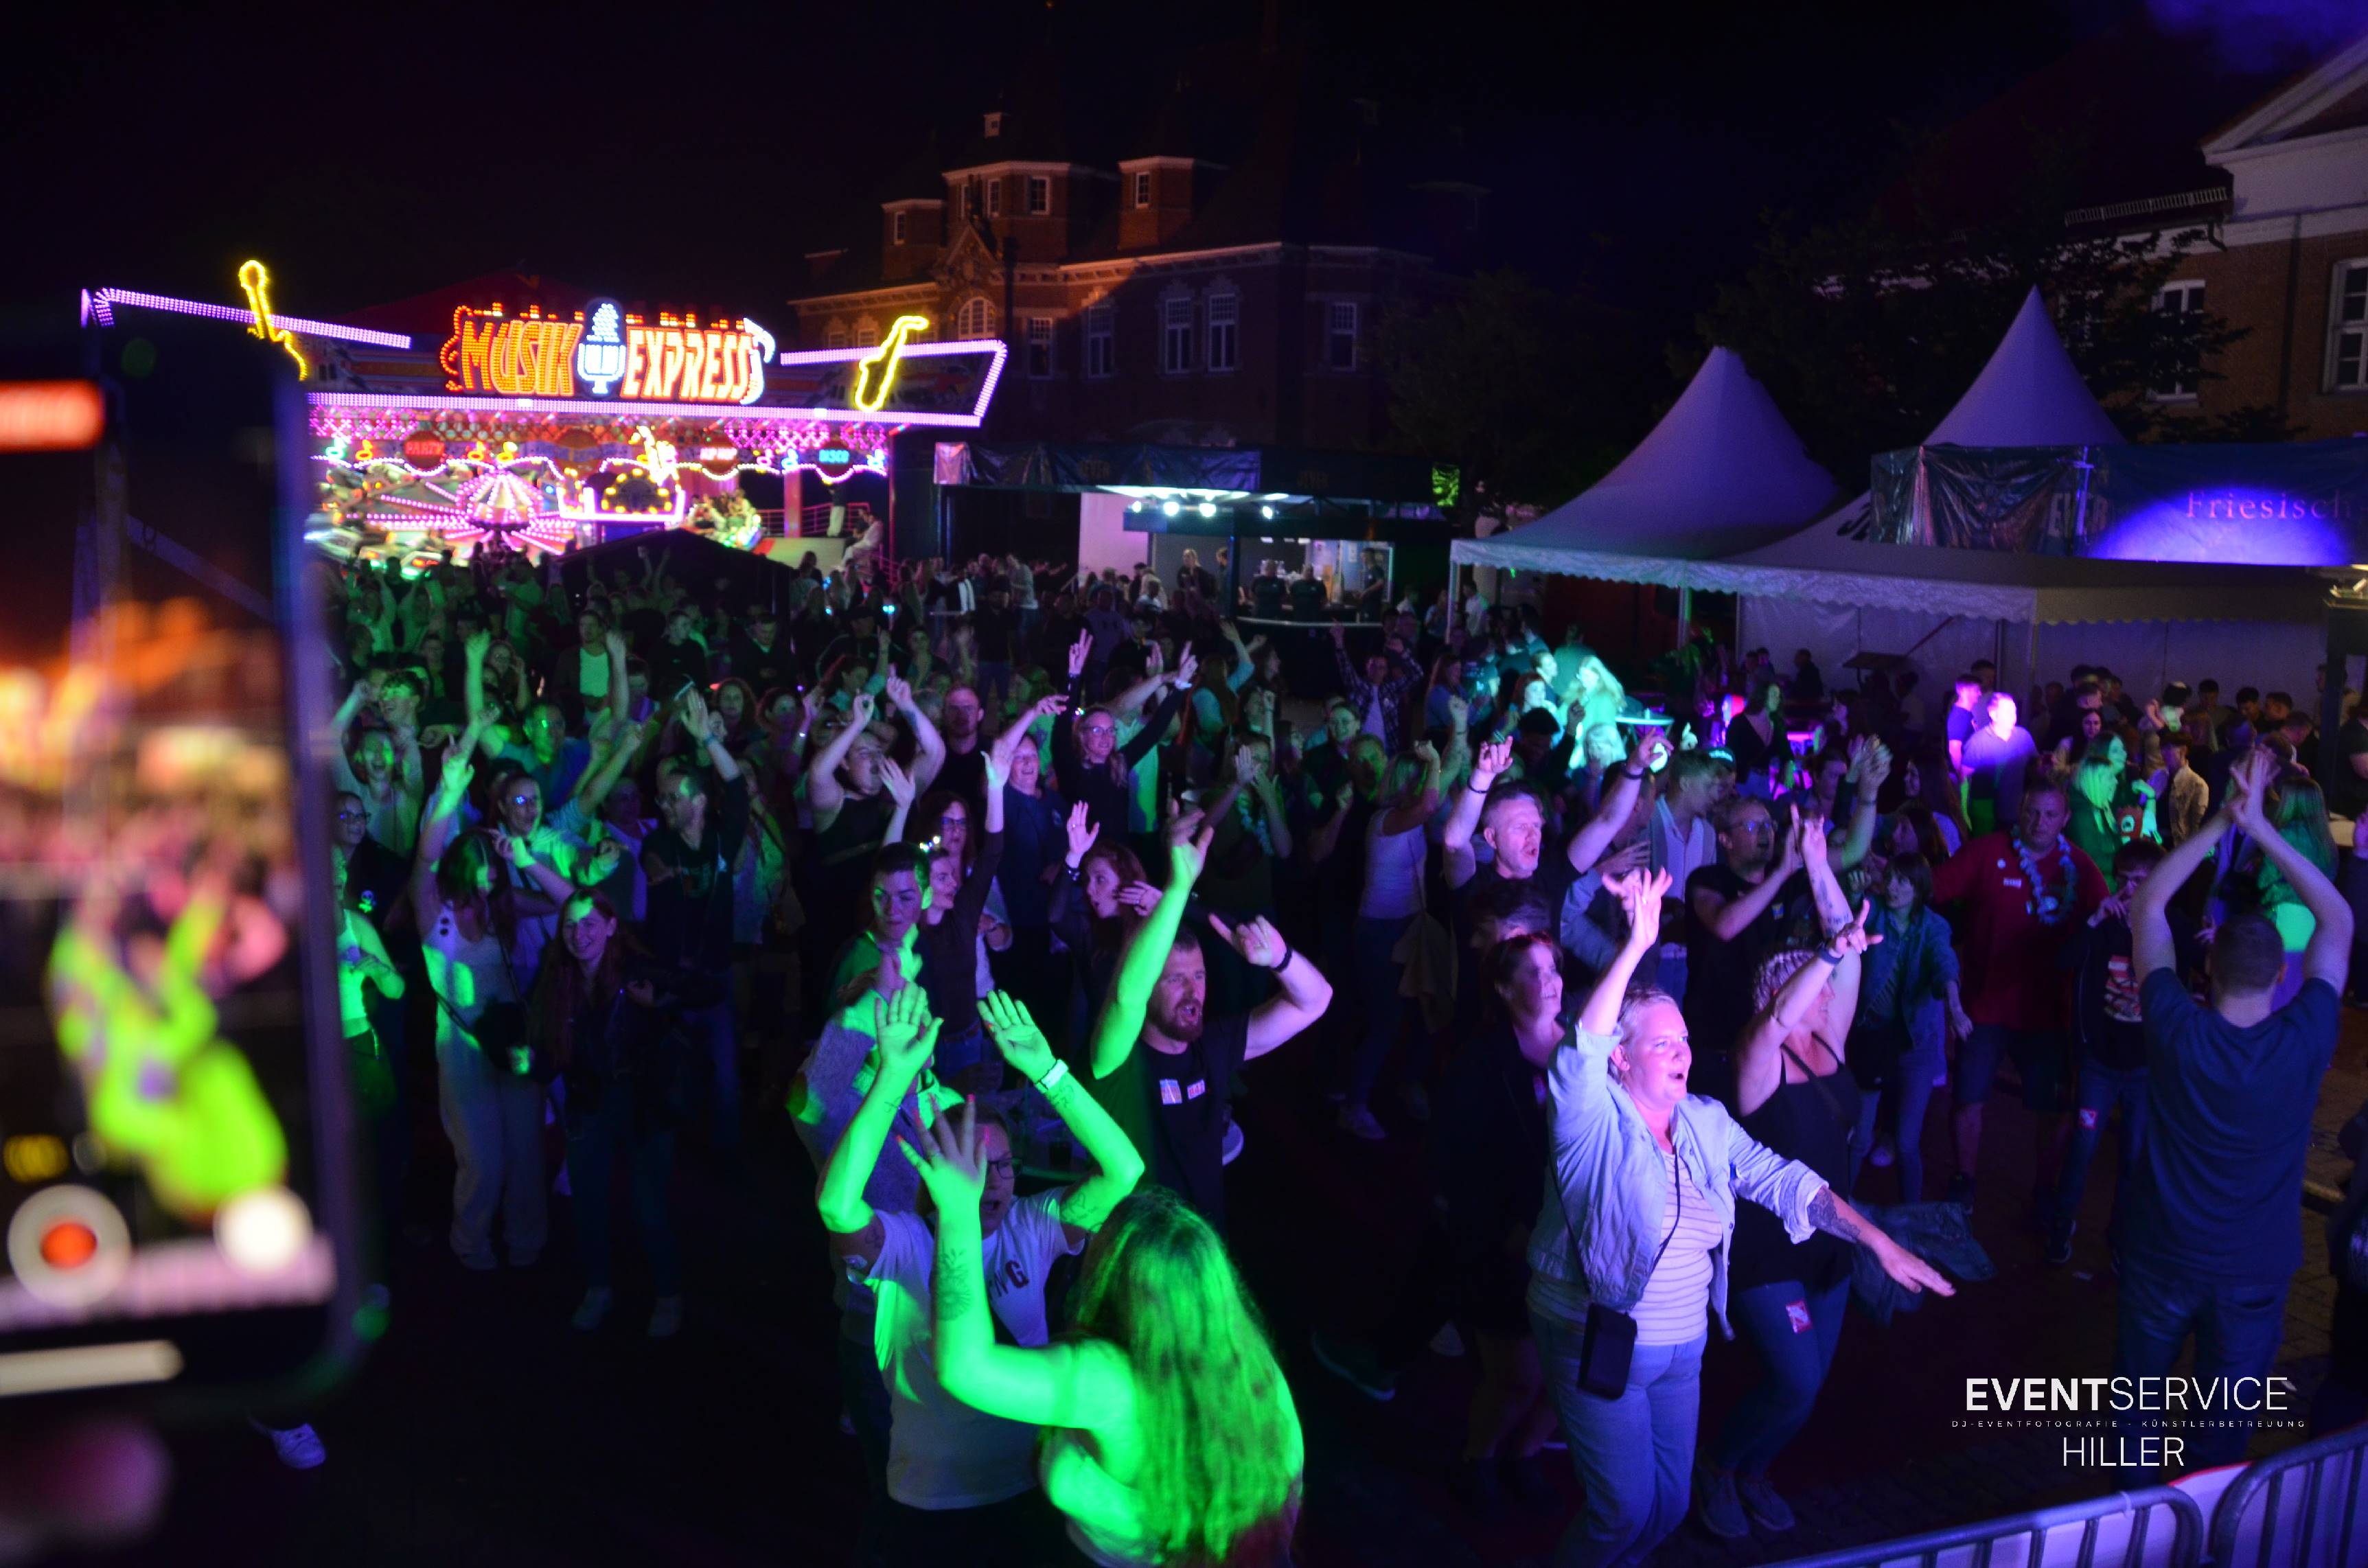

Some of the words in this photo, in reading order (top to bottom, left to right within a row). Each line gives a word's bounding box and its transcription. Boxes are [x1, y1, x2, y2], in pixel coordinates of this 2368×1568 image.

[460, 320, 584, 397] MUSIK
[619, 325, 756, 402] EXPRESS
[405, 441, 446, 455] PARTY
[818, 448, 850, 463] DISCO
